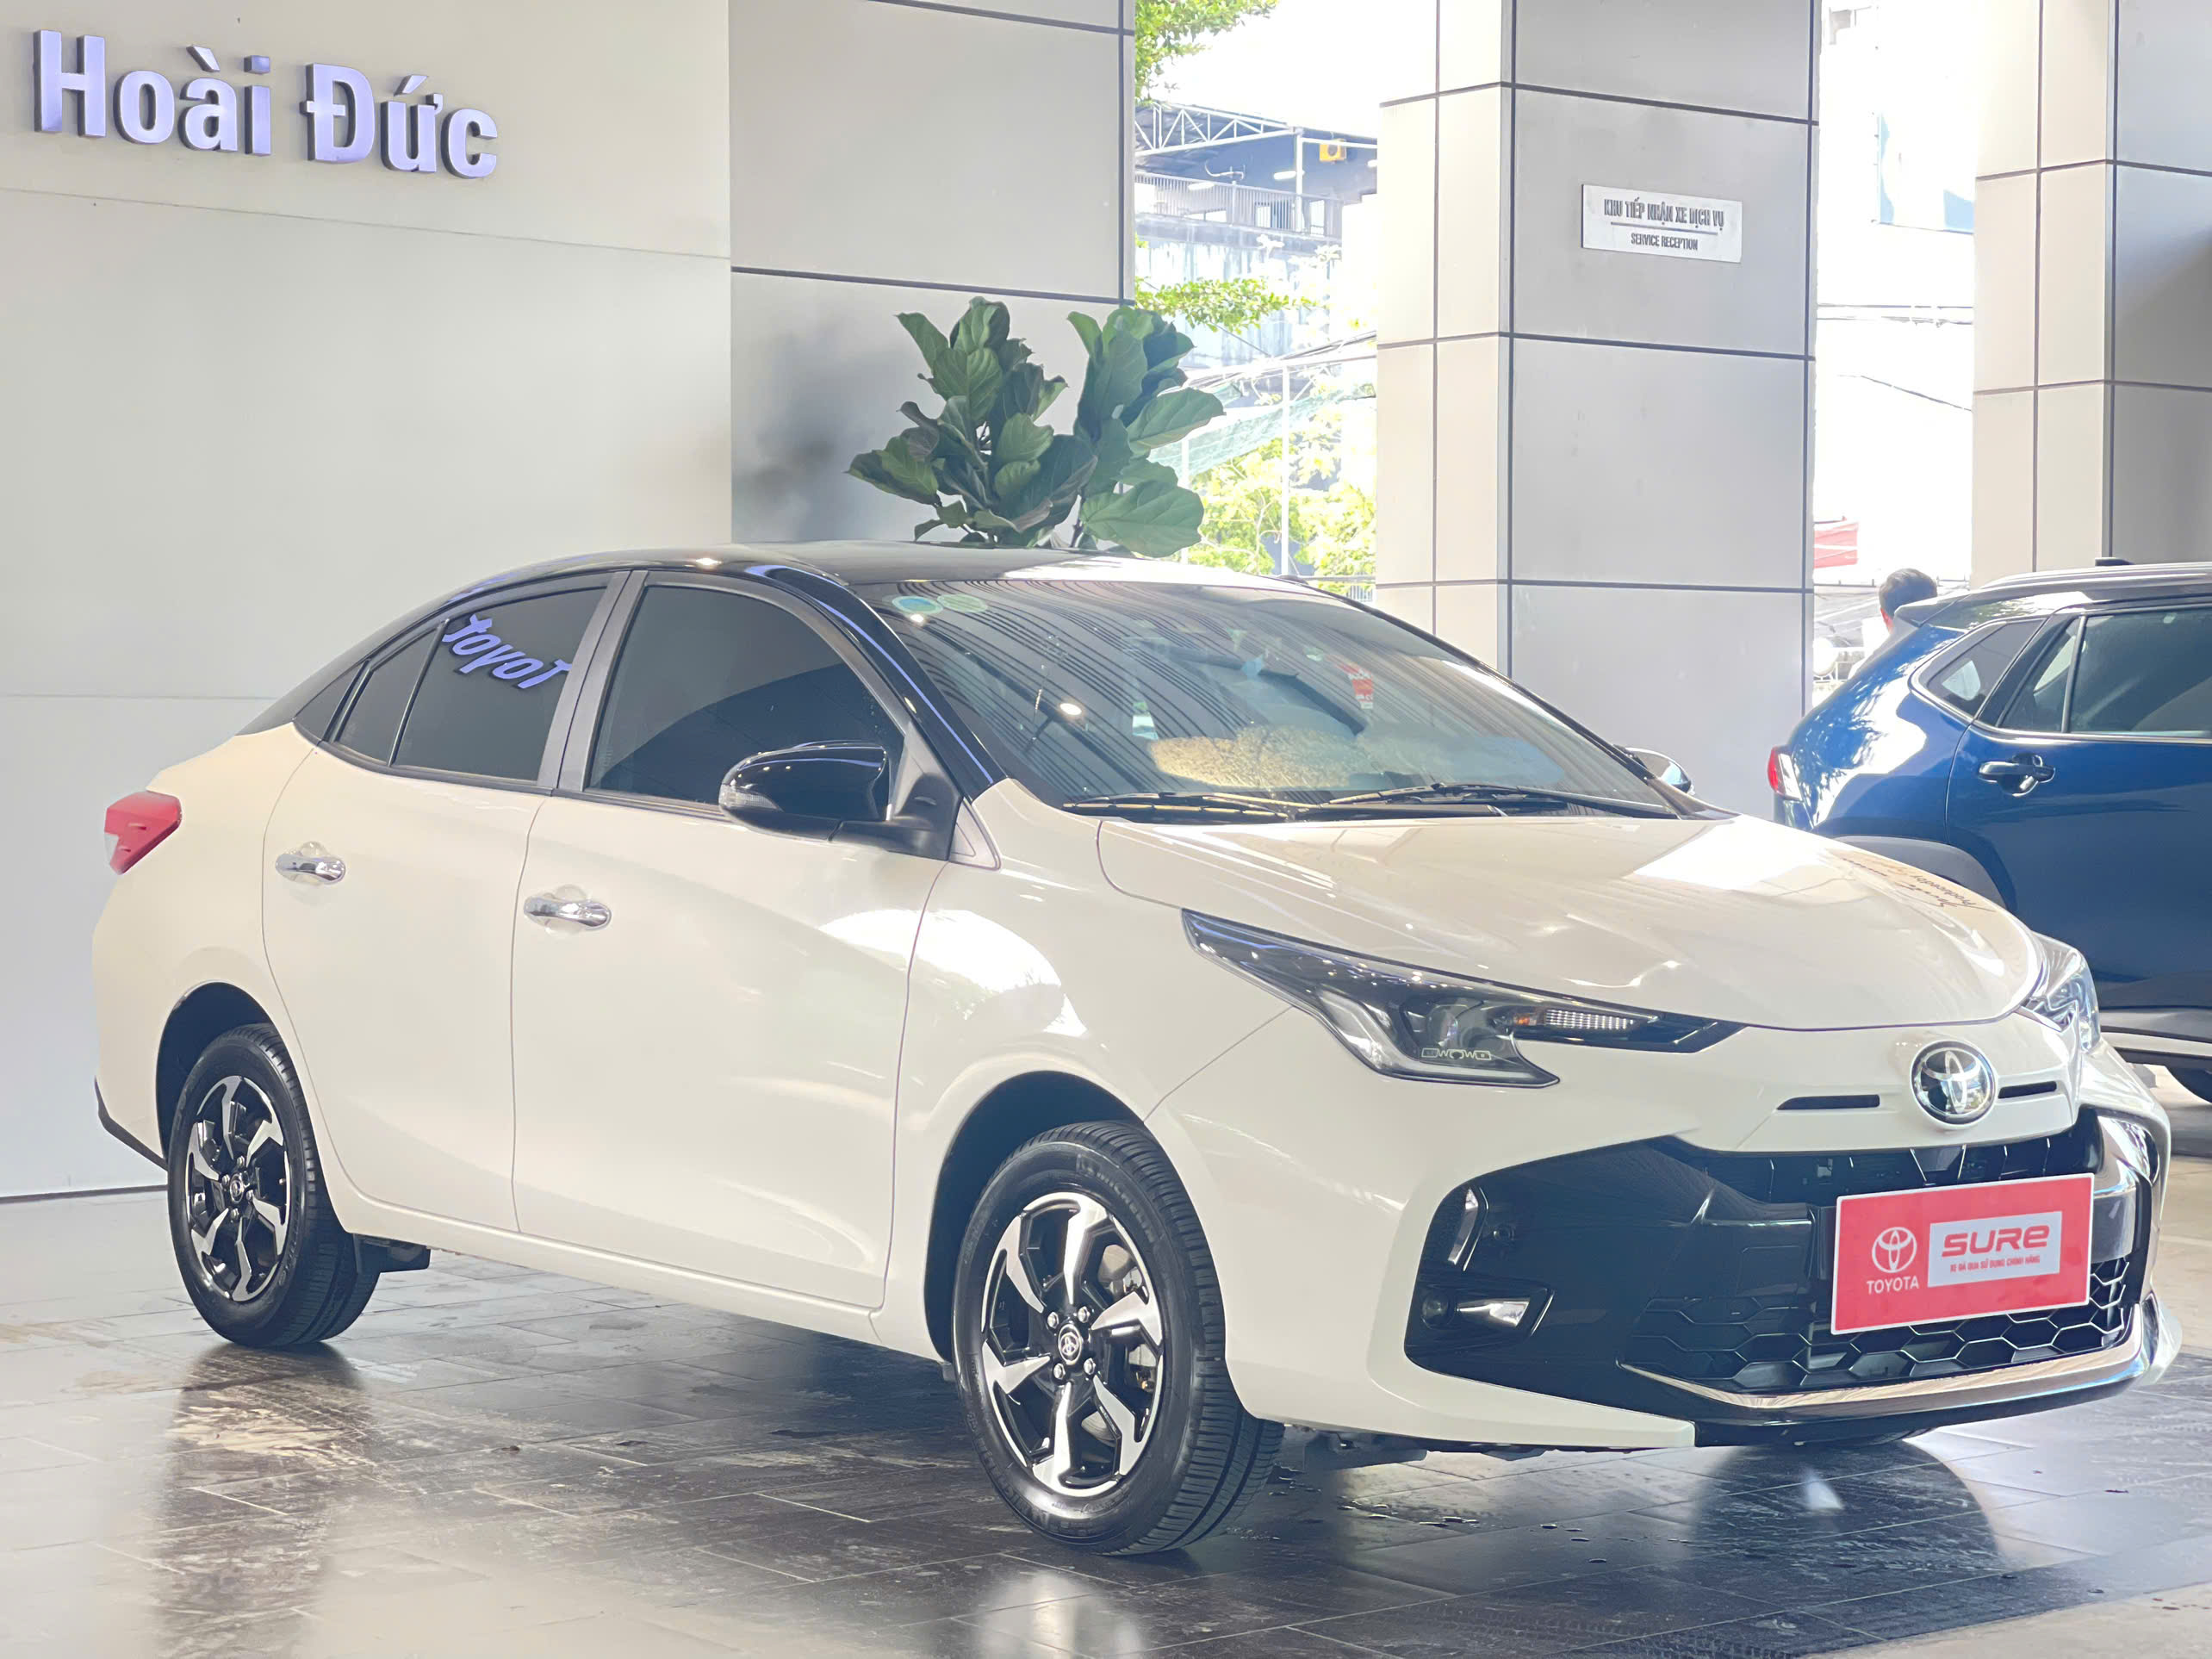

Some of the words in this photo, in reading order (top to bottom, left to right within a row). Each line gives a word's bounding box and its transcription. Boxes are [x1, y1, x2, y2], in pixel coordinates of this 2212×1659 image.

[33, 29, 271, 157] Hoài
[299, 63, 499, 179] Đức
[1604, 199, 1624, 217] KHU
[1625, 196, 1645, 219] TIẾP
[1647, 201, 1674, 225] NHẬN
[1675, 206, 1687, 224] XE
[1689, 208, 1711, 228] DỊCH
[1712, 209, 1724, 231] VỤ
[1631, 233, 1660, 247] SERVICE
[1661, 235, 1699, 251] RECEPTION
[1867, 1275, 1920, 1295] TOYOTA
